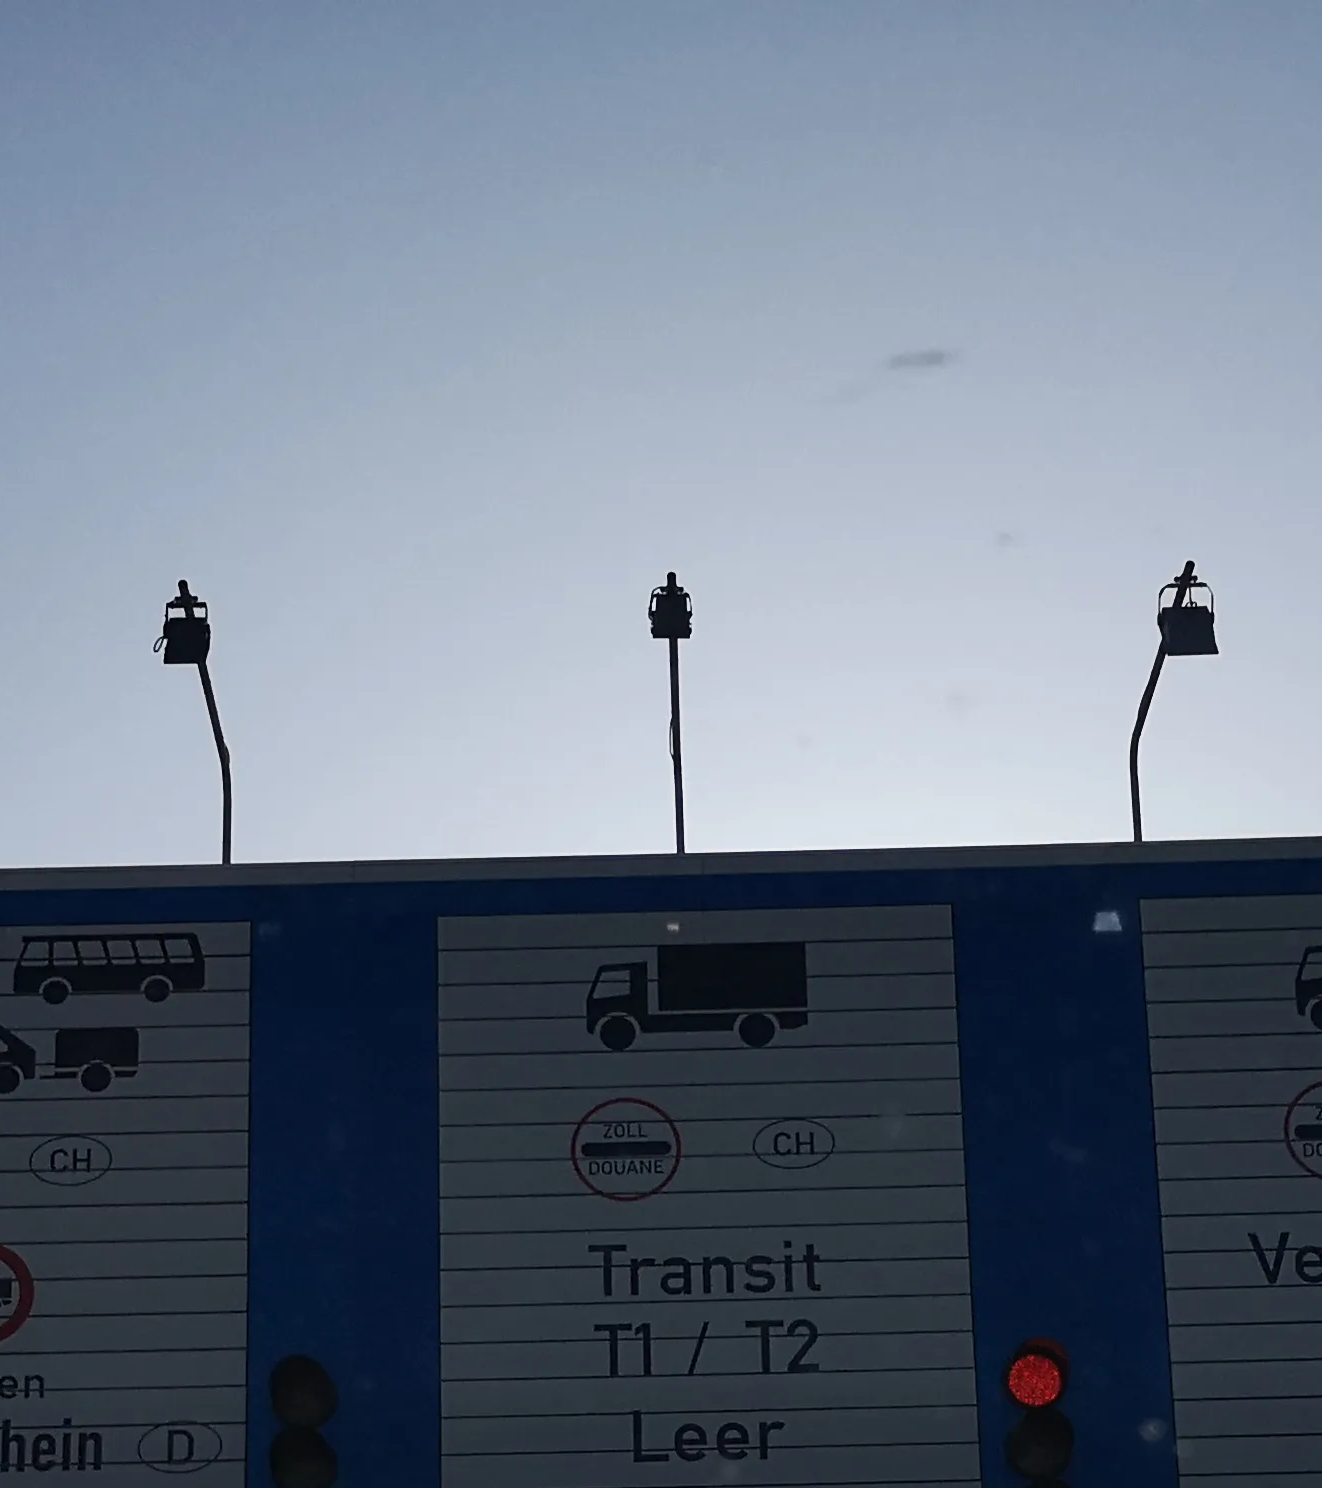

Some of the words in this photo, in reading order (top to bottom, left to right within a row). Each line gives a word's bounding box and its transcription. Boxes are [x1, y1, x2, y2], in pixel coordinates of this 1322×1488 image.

[602, 1122, 648, 1139] ZOLL
[771, 1132, 816, 1156] CH
[49, 1147, 93, 1173] CH
[588, 1158, 665, 1176] DOUANE
[587, 1240, 822, 1297] Transit
[593, 1323, 653, 1378] T1
[686, 1321, 710, 1377] /
[744, 1318, 821, 1374] T2
[165, 1429, 195, 1465] D
[632, 1410, 786, 1463] Leer
